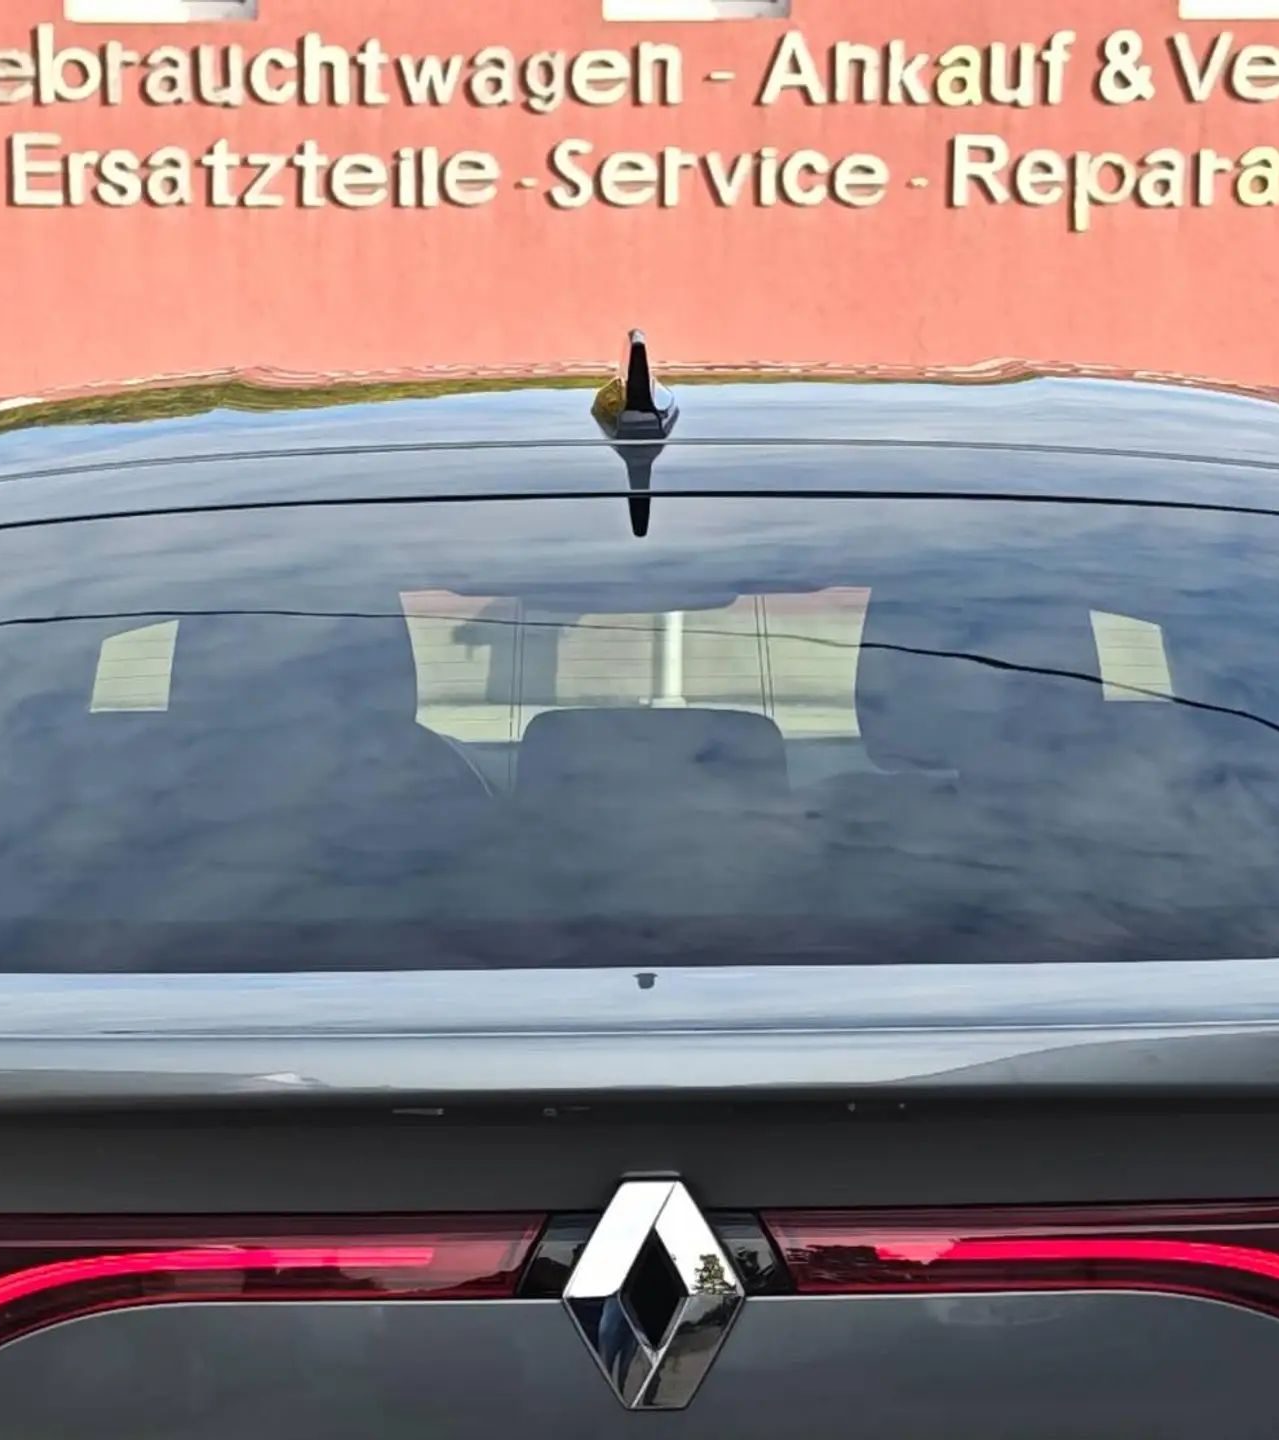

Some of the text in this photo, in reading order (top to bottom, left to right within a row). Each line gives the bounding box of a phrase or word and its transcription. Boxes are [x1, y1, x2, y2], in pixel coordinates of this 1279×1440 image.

[759, 29, 1077, 107] Ankauf
[1097, 28, 1157, 106] &
[9, 132, 502, 208] Ersatzteile
[546, 137, 891, 208] Service
